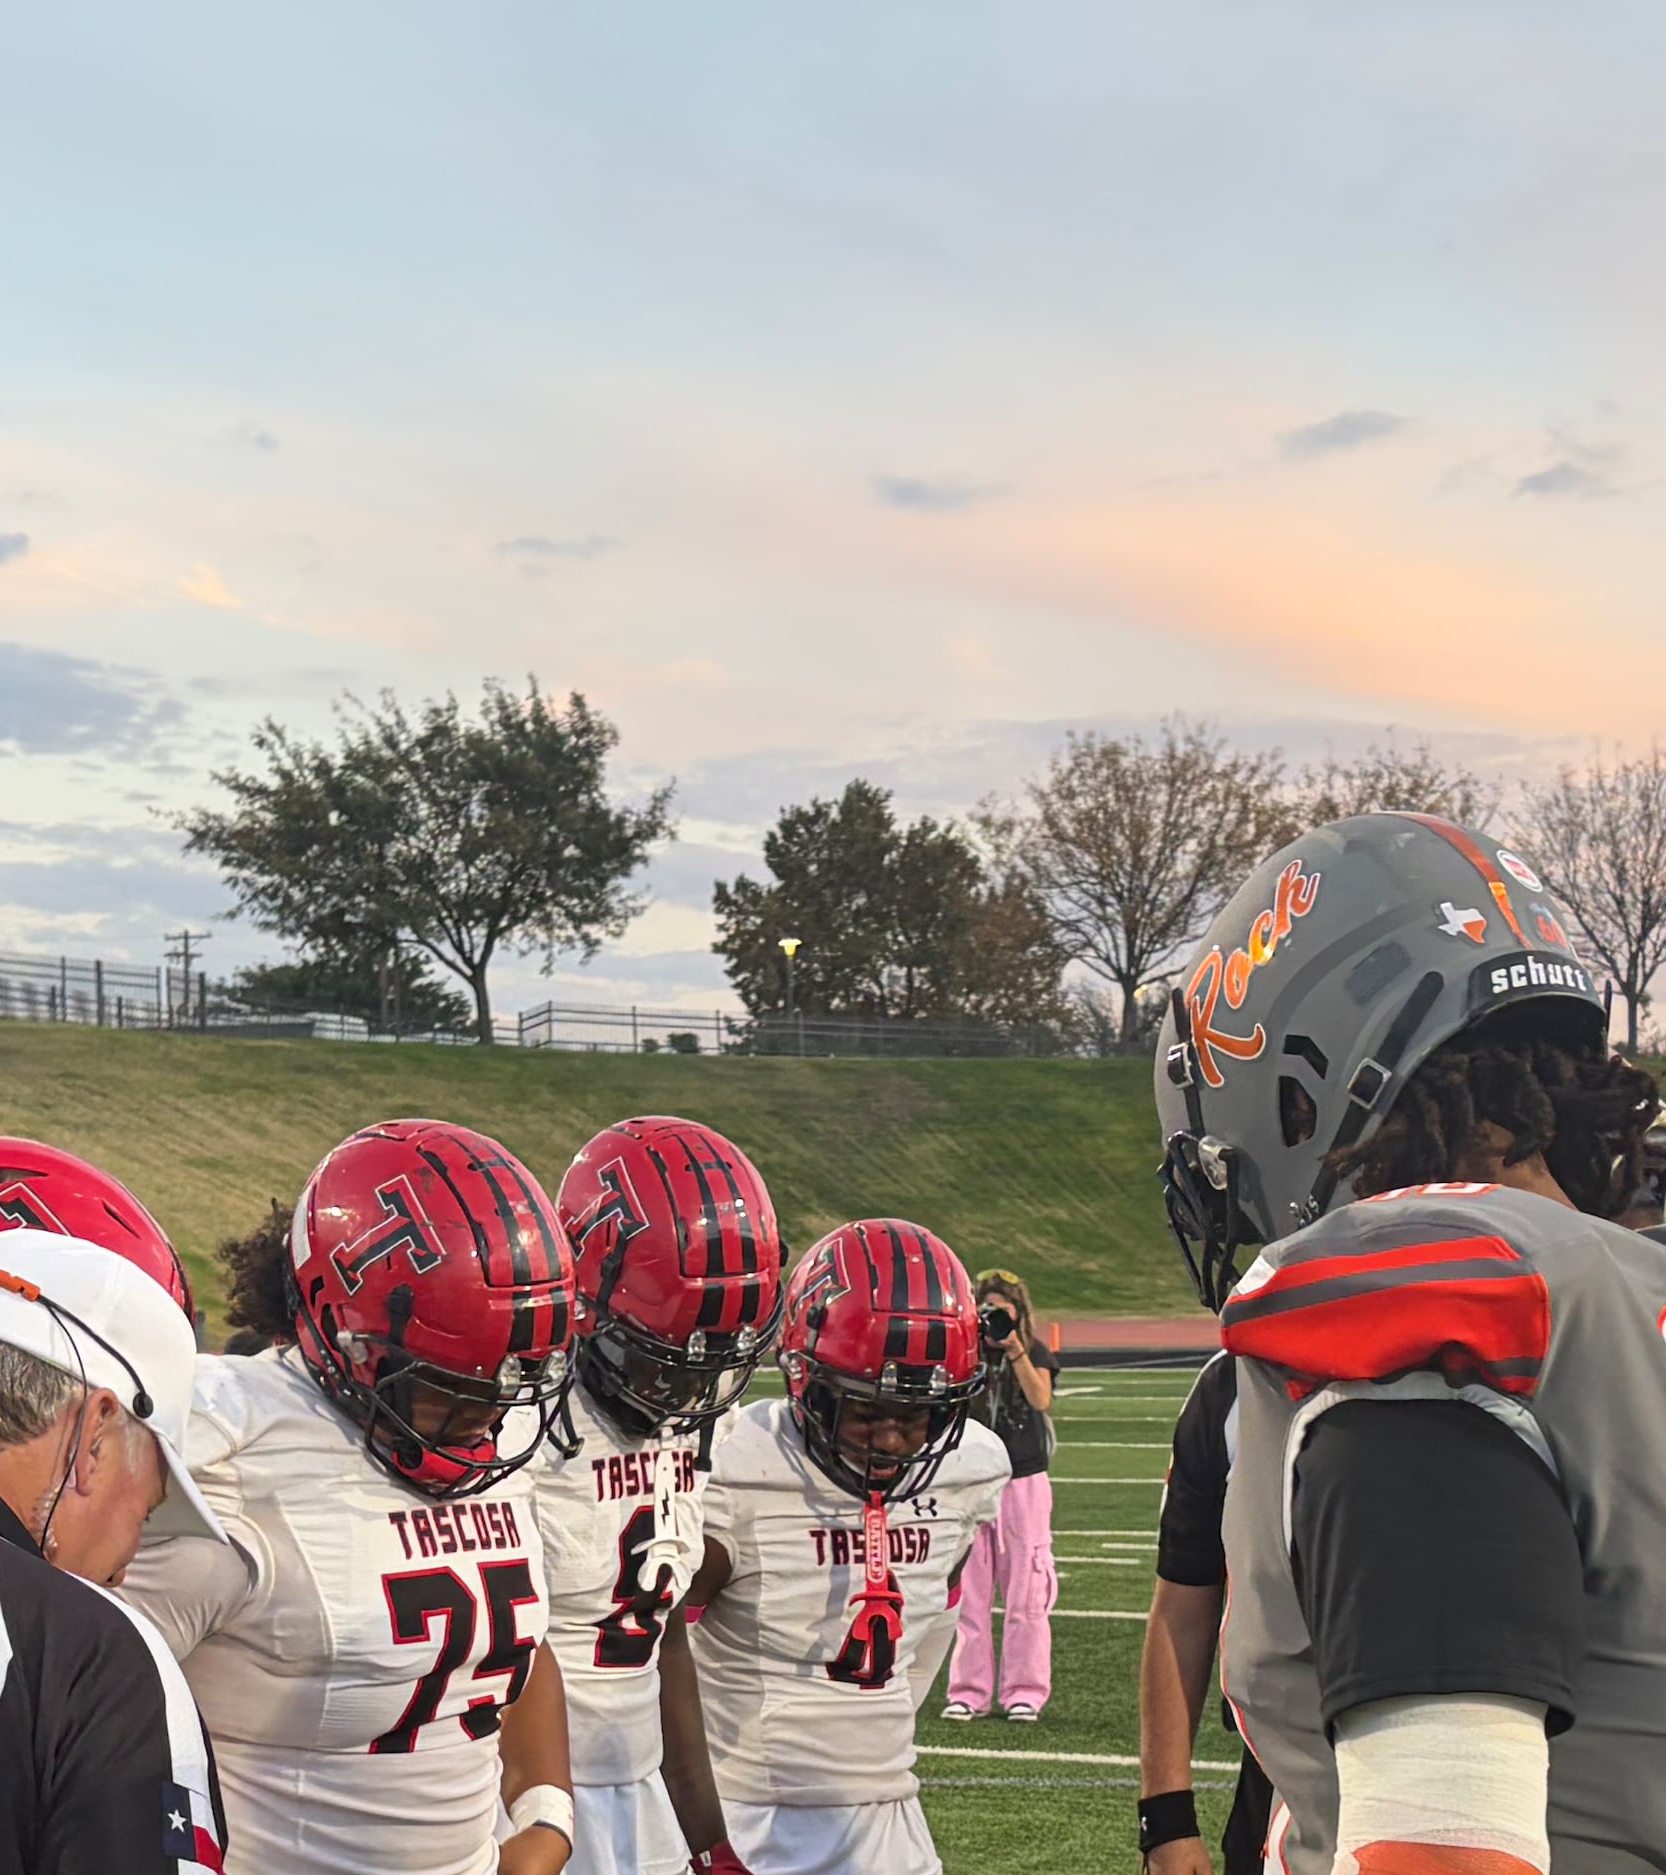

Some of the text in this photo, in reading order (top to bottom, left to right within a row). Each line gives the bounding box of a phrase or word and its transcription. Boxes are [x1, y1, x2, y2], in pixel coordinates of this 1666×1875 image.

[1183, 858, 1322, 1089] Rock
[330, 1174, 447, 1296] T
[591, 1449, 696, 1503] TASCSA
[388, 1501, 522, 1561] TASCOSA
[808, 1527, 932, 1568] TASOSA
[367, 1558, 540, 1755] 75
